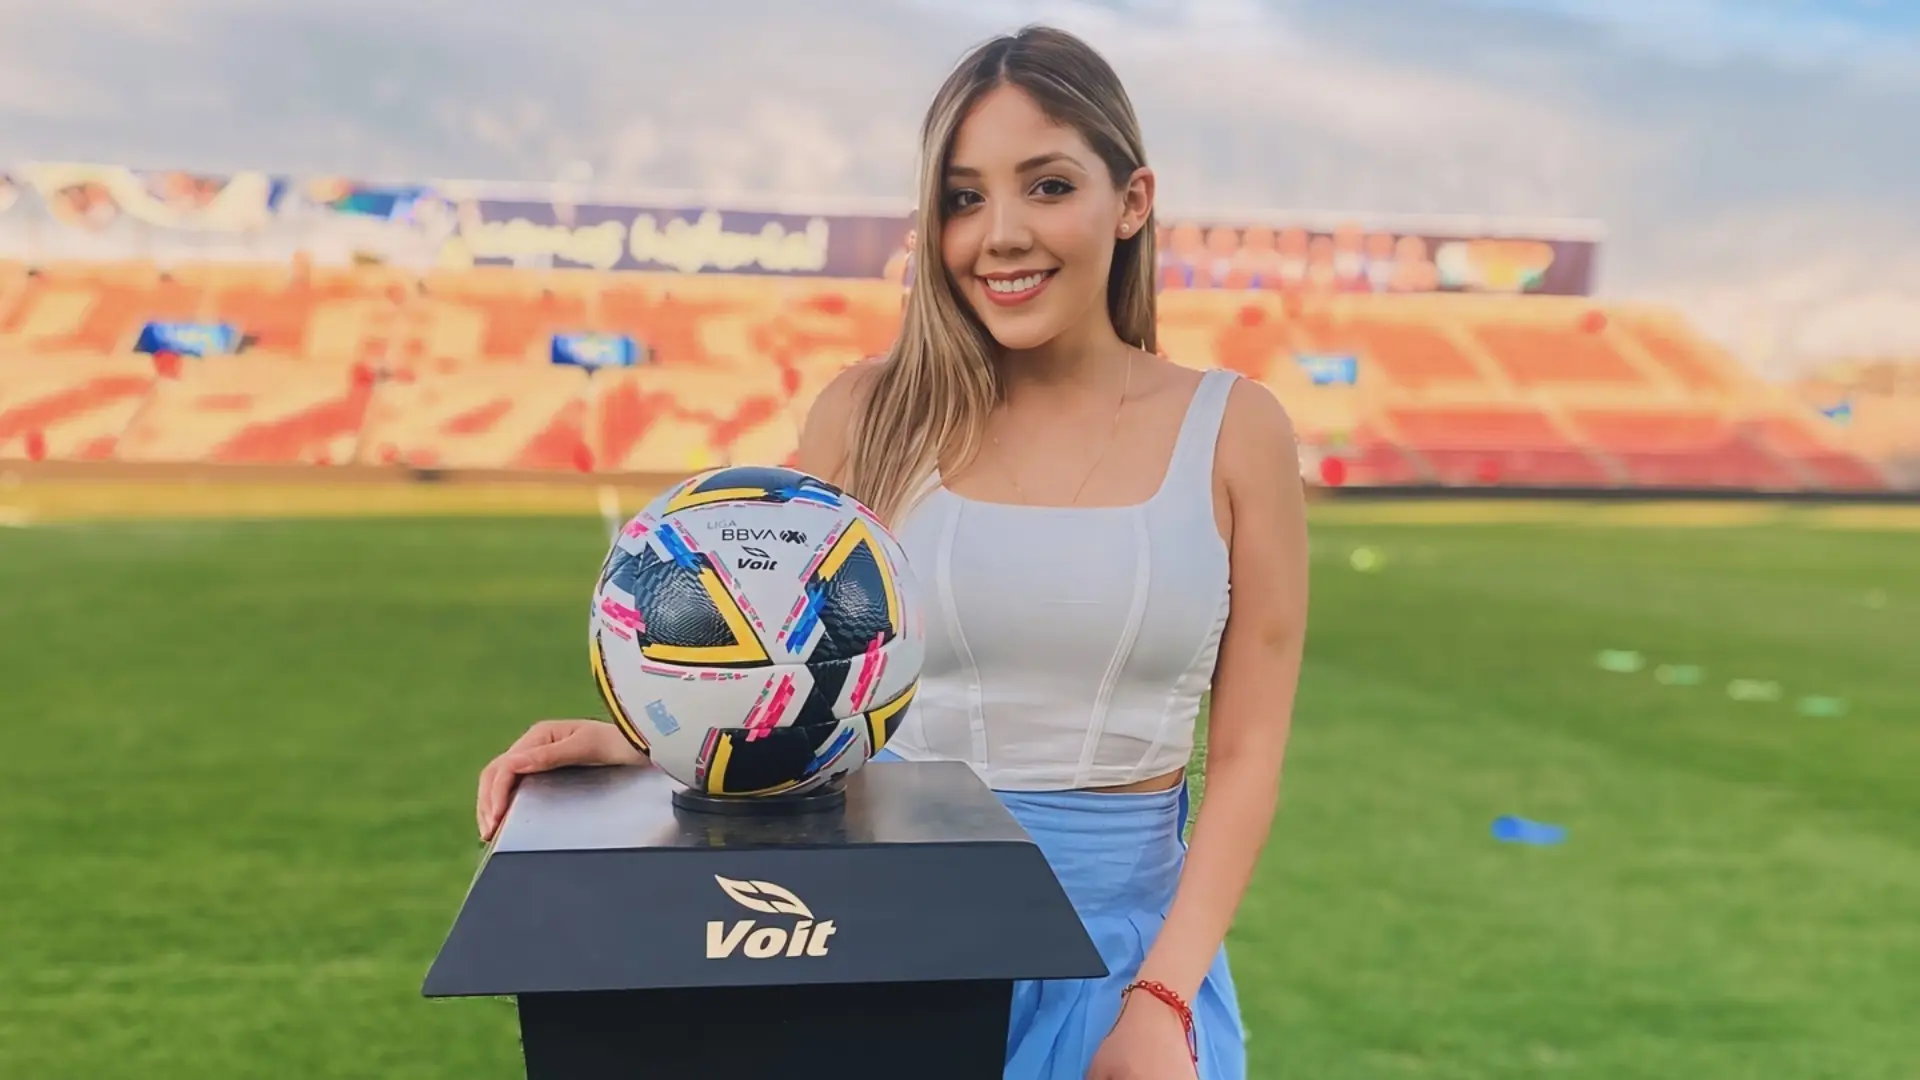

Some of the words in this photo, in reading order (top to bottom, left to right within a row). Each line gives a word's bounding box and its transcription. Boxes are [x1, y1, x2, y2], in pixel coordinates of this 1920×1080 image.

[707, 520, 737, 530] LIGA
[721, 528, 777, 541] BBVA
[737, 557, 778, 571] Voit
[706, 919, 837, 959] Voit
